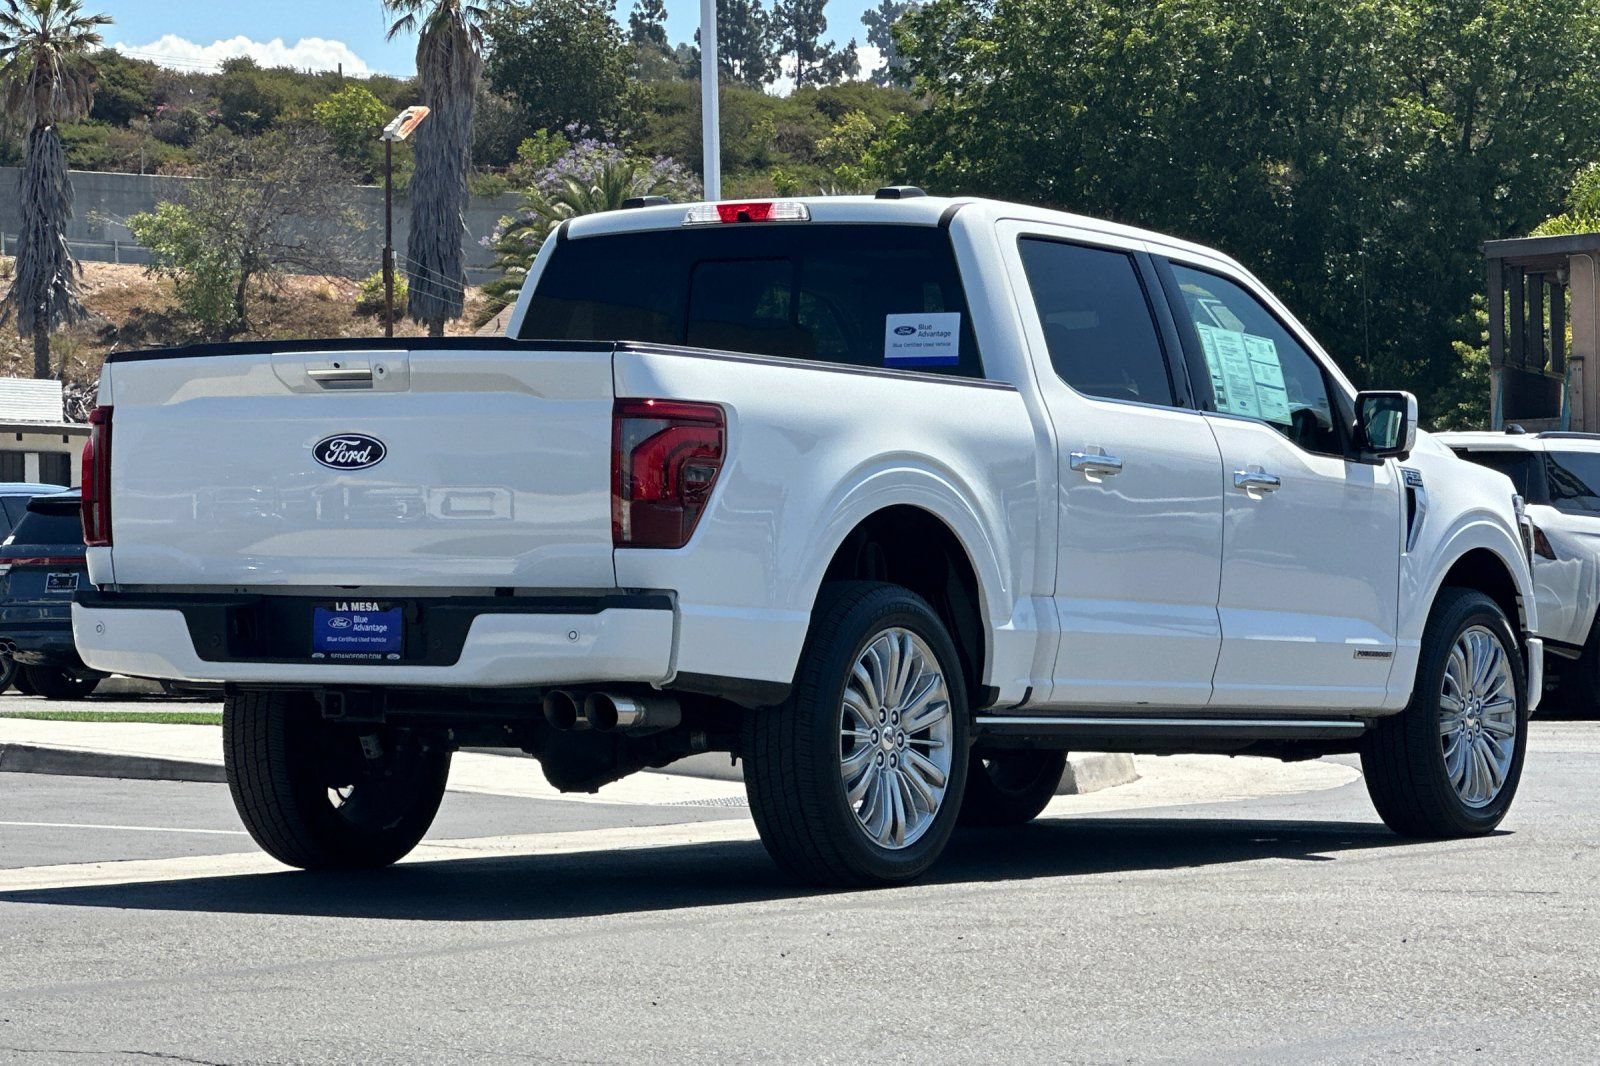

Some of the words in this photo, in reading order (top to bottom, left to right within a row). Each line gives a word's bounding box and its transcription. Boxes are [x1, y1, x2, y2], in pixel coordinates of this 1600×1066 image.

[325, 439, 372, 463] Ford
[335, 602, 349, 611] LA
[351, 602, 379, 611] MESA
[353, 615, 368, 623] Blue
[353, 624, 388, 633] Advantage
